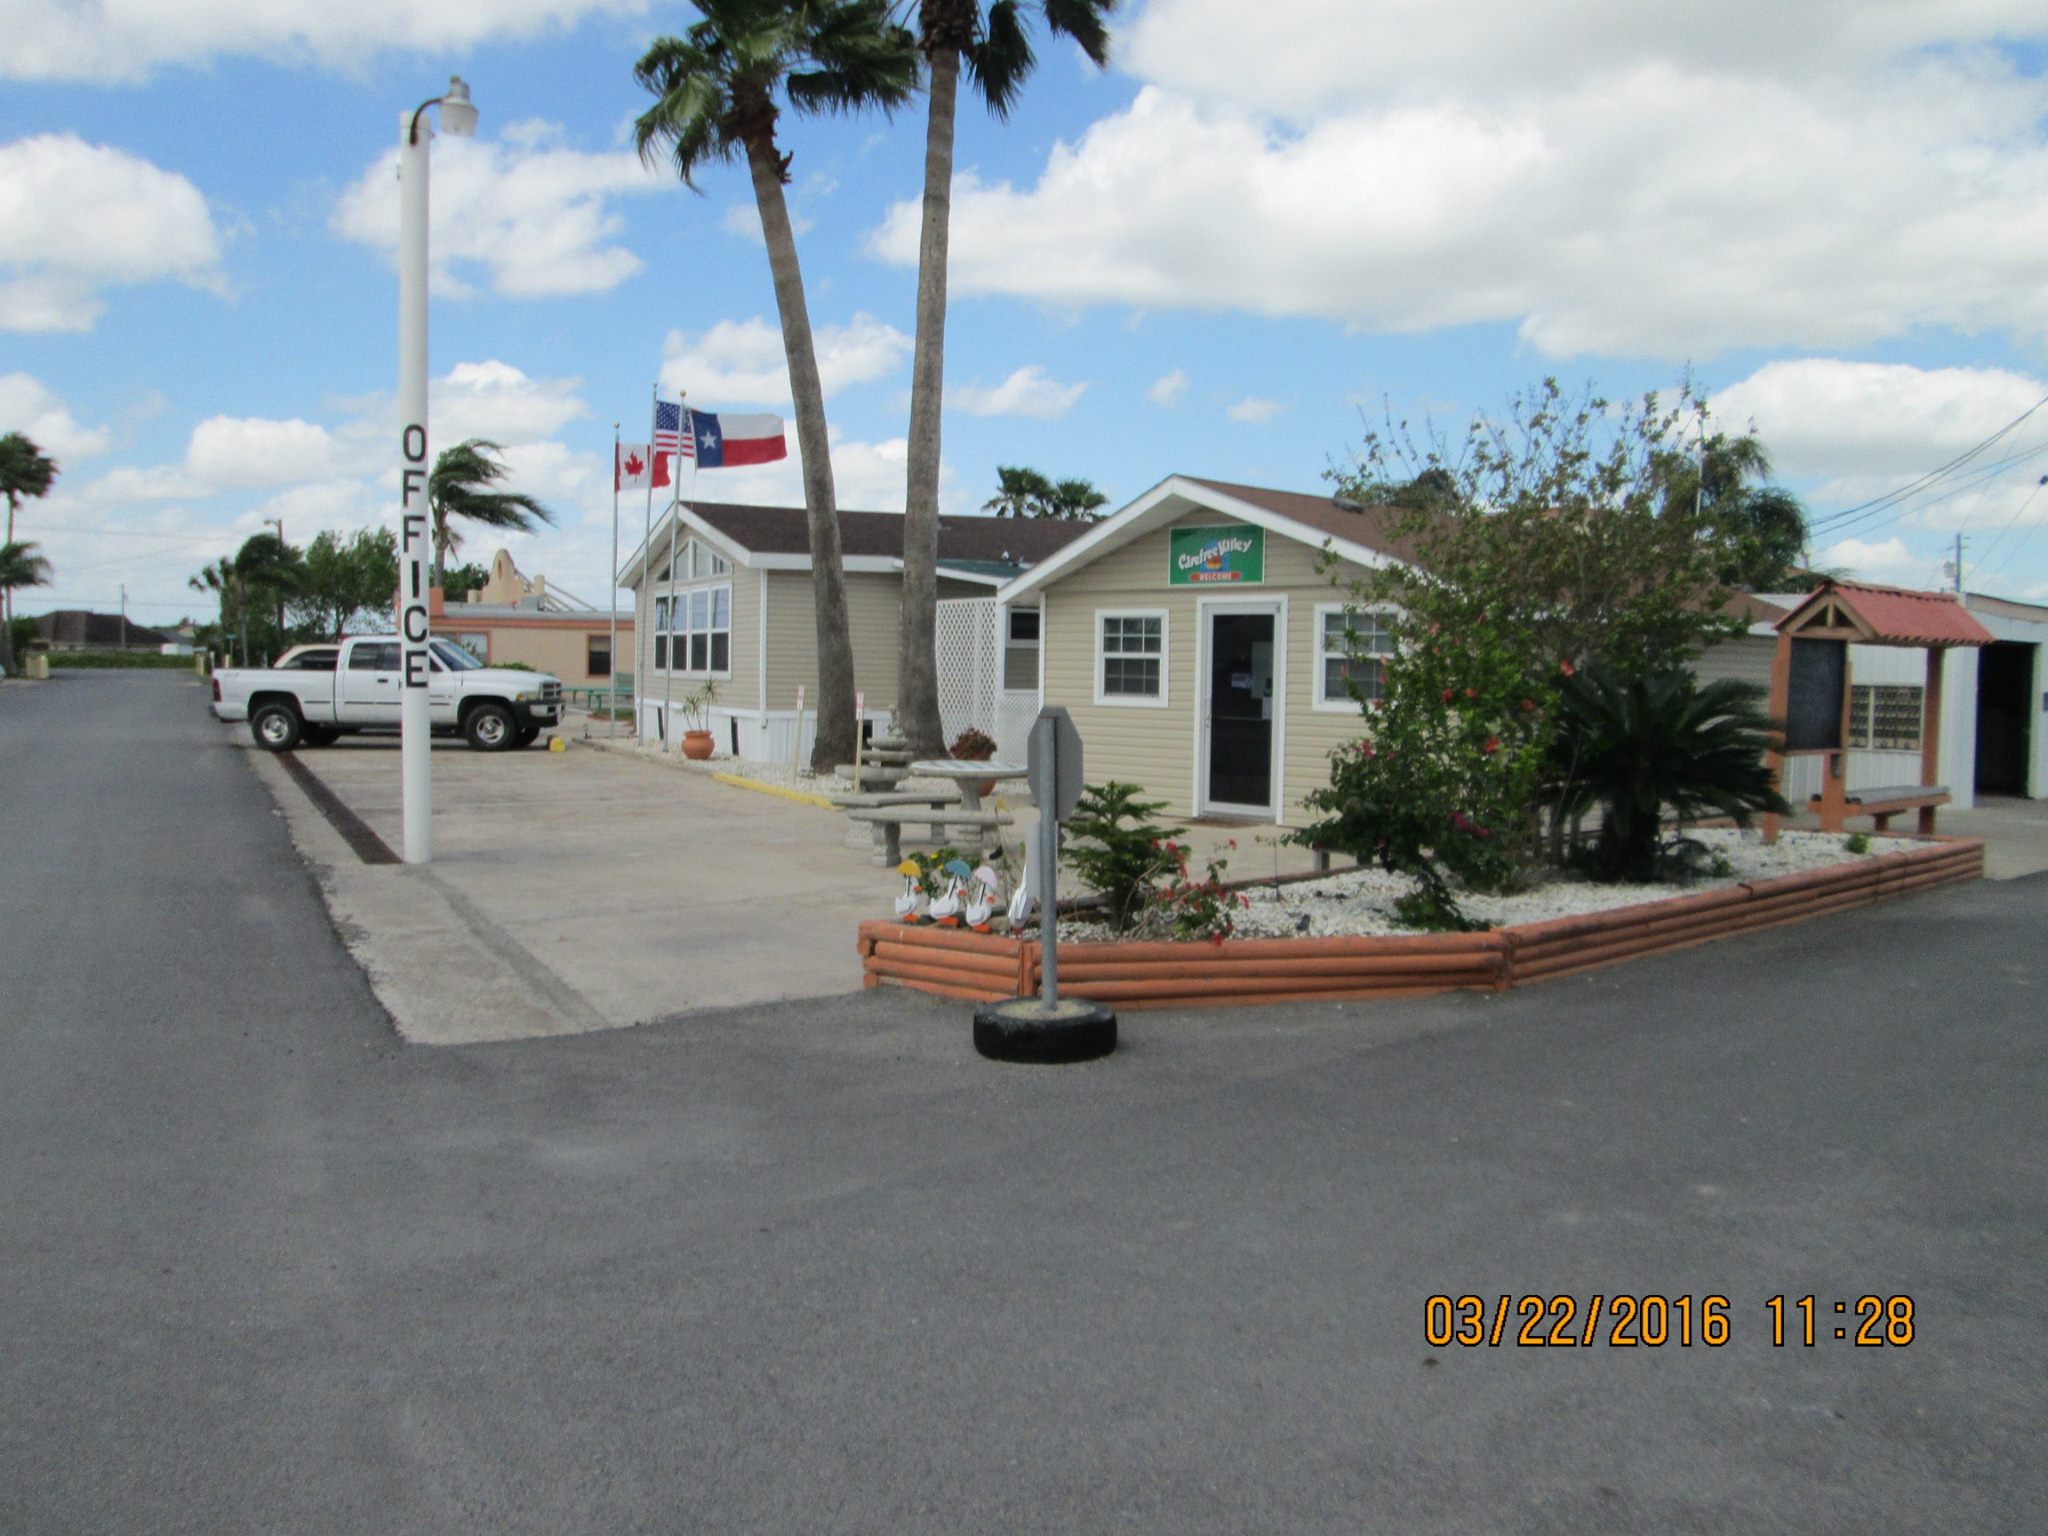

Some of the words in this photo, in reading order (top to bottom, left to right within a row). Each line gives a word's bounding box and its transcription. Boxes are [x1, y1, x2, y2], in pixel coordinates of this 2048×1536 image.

[402, 424, 428, 688] OFFICE
[1217, 537, 1253, 556] Valley
[1199, 572, 1232, 581] WELCOME
